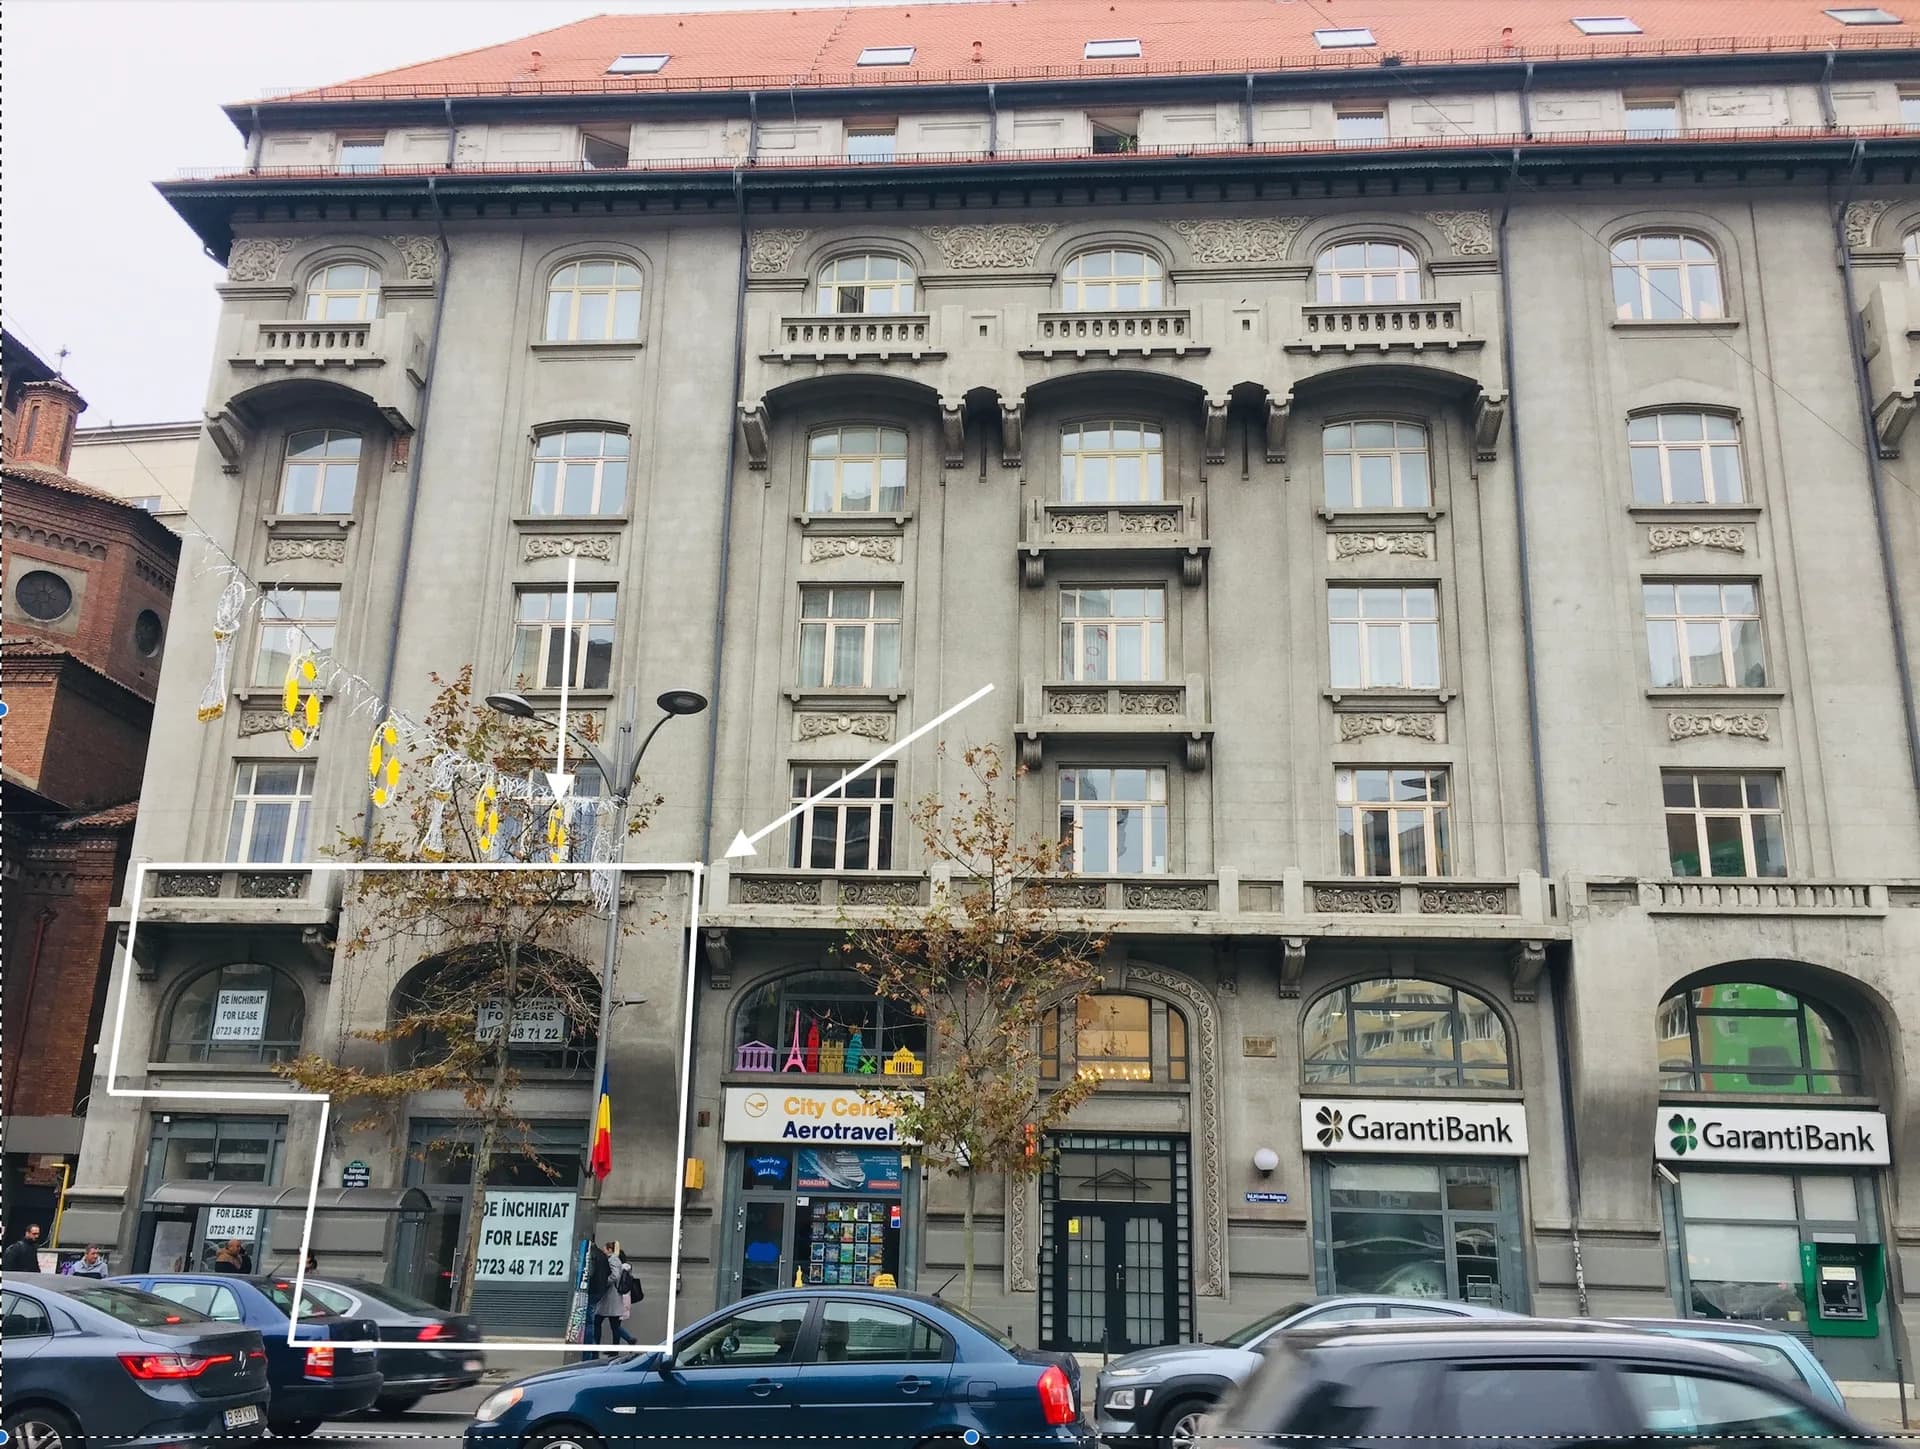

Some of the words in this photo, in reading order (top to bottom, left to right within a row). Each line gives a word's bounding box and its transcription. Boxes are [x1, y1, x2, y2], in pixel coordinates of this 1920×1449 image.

[221, 995, 230, 1004] DE
[223, 1011, 236, 1020] FOR
[238, 1011, 258, 1020] LEASE
[488, 1011, 505, 1020] FO
[216, 1026, 232, 1036] 0723
[243, 1027, 250, 1036] 71
[252, 1027, 260, 1036] 22
[480, 1027, 502, 1039] 072
[510, 1028, 524, 1039] 48
[528, 1028, 540, 1039] 71
[544, 1028, 559, 1040] 22
[783, 1096, 826, 1120] City
[782, 1120, 894, 1141] Aerotravel
[1347, 1114, 1513, 1143] GarantiBank
[1702, 1122, 1875, 1152] GarantiBank
[216, 1208, 230, 1218] FOR
[231, 1209, 253, 1218] LEASE
[501, 1198, 570, 1218] ÎNCHIRIAT
[210, 1225, 226, 1235] 0723
[237, 1226, 245, 1235] 71
[247, 1226, 255, 1235] 22
[485, 1230, 512, 1246] FOR
[515, 1231, 559, 1247] LEASE
[476, 1258, 505, 1275] 0723
[508, 1260, 525, 1275] 48
[529, 1260, 543, 1275] 71
[548, 1260, 564, 1276] 22
